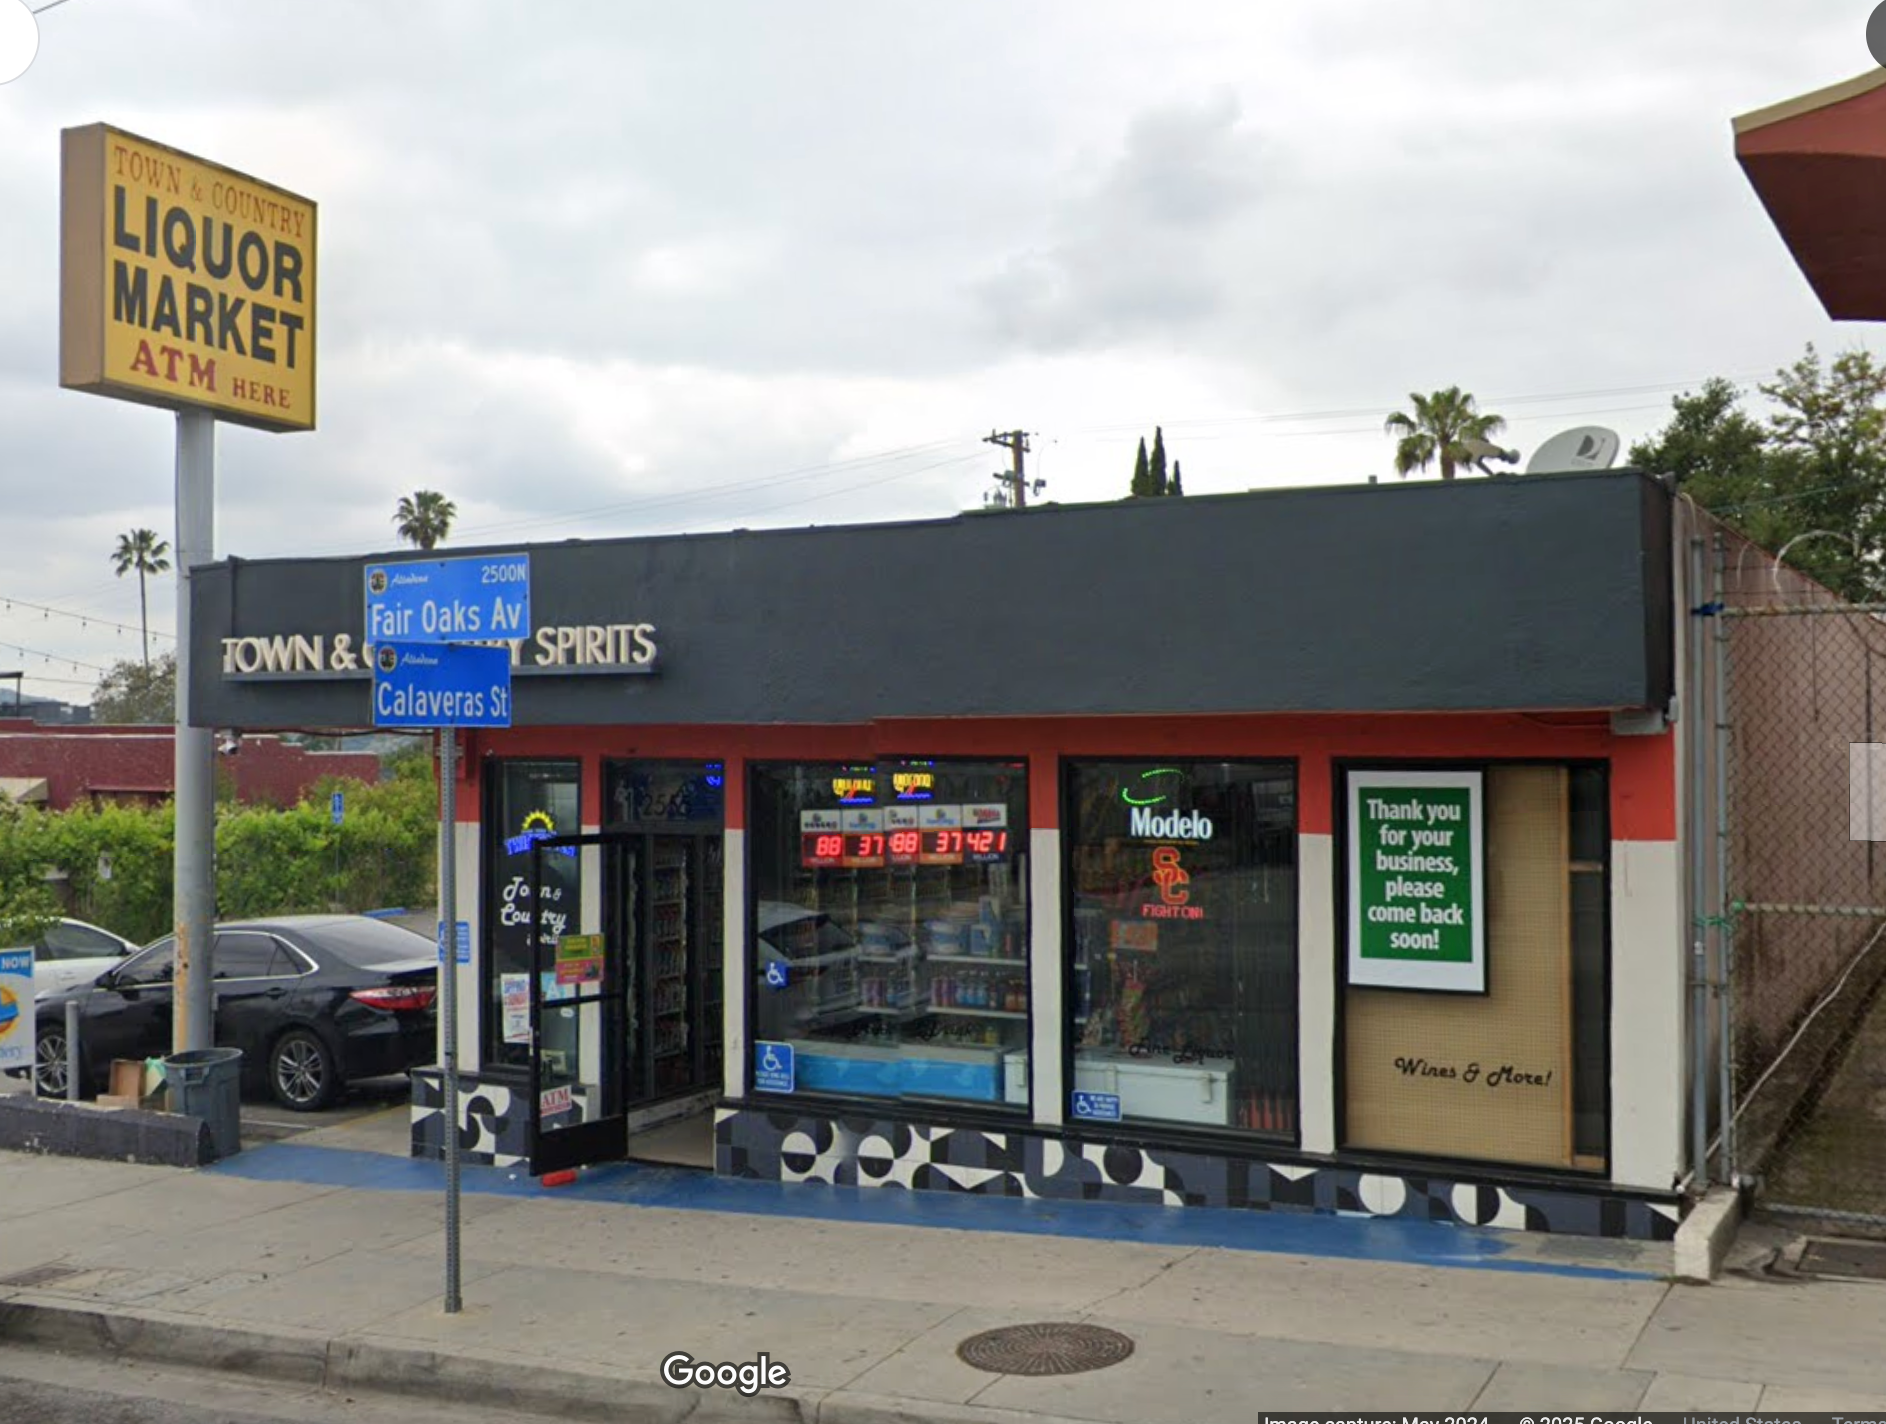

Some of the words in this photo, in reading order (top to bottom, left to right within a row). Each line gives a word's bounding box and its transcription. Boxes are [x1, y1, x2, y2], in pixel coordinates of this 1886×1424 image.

[115, 145, 181, 194] TOWN
[190, 178, 203, 202] &
[212, 181, 305, 238] COUNTRY
[114, 185, 304, 303] LIQUOR
[113, 260, 304, 369] MARKET
[130, 339, 217, 392] ATM
[232, 377, 291, 409] HERE
[481, 563, 527, 583] 2500N
[371, 602, 413, 636] Fair
[422, 599, 480, 633] Oaks
[490, 596, 522, 631] Av
[221, 635, 324, 673] TOWN
[331, 633, 357, 670] &
[535, 623, 656, 666] SPIRITS
[378, 682, 484, 718] Calaveras
[490, 685, 508, 718] St
[1131, 807, 1213, 839] Modelo
[1367, 799, 1423, 821] Thank
[1427, 803, 1461, 825] you
[815, 835, 842, 857] 88
[858, 835, 884, 856] 37
[936, 831, 963, 852] 37
[1379, 824, 1406, 846] for
[1411, 830, 1454, 851] your
[1376, 851, 1459, 874] business,
[502, 875, 552, 902] Ton
[1385, 877, 1444, 901] please
[500, 902, 567, 934] Coutry
[1142, 904, 1180, 918] FIGHT
[1368, 907, 1416, 923] come
[1421, 904, 1464, 925] back
[1390, 929, 1440, 951] soon!
[1394, 1057, 1456, 1079] Wines
[1463, 1062, 1480, 1083] &
[1487, 1065, 1552, 1087] More!
[541, 1088, 569, 1107] ATM
